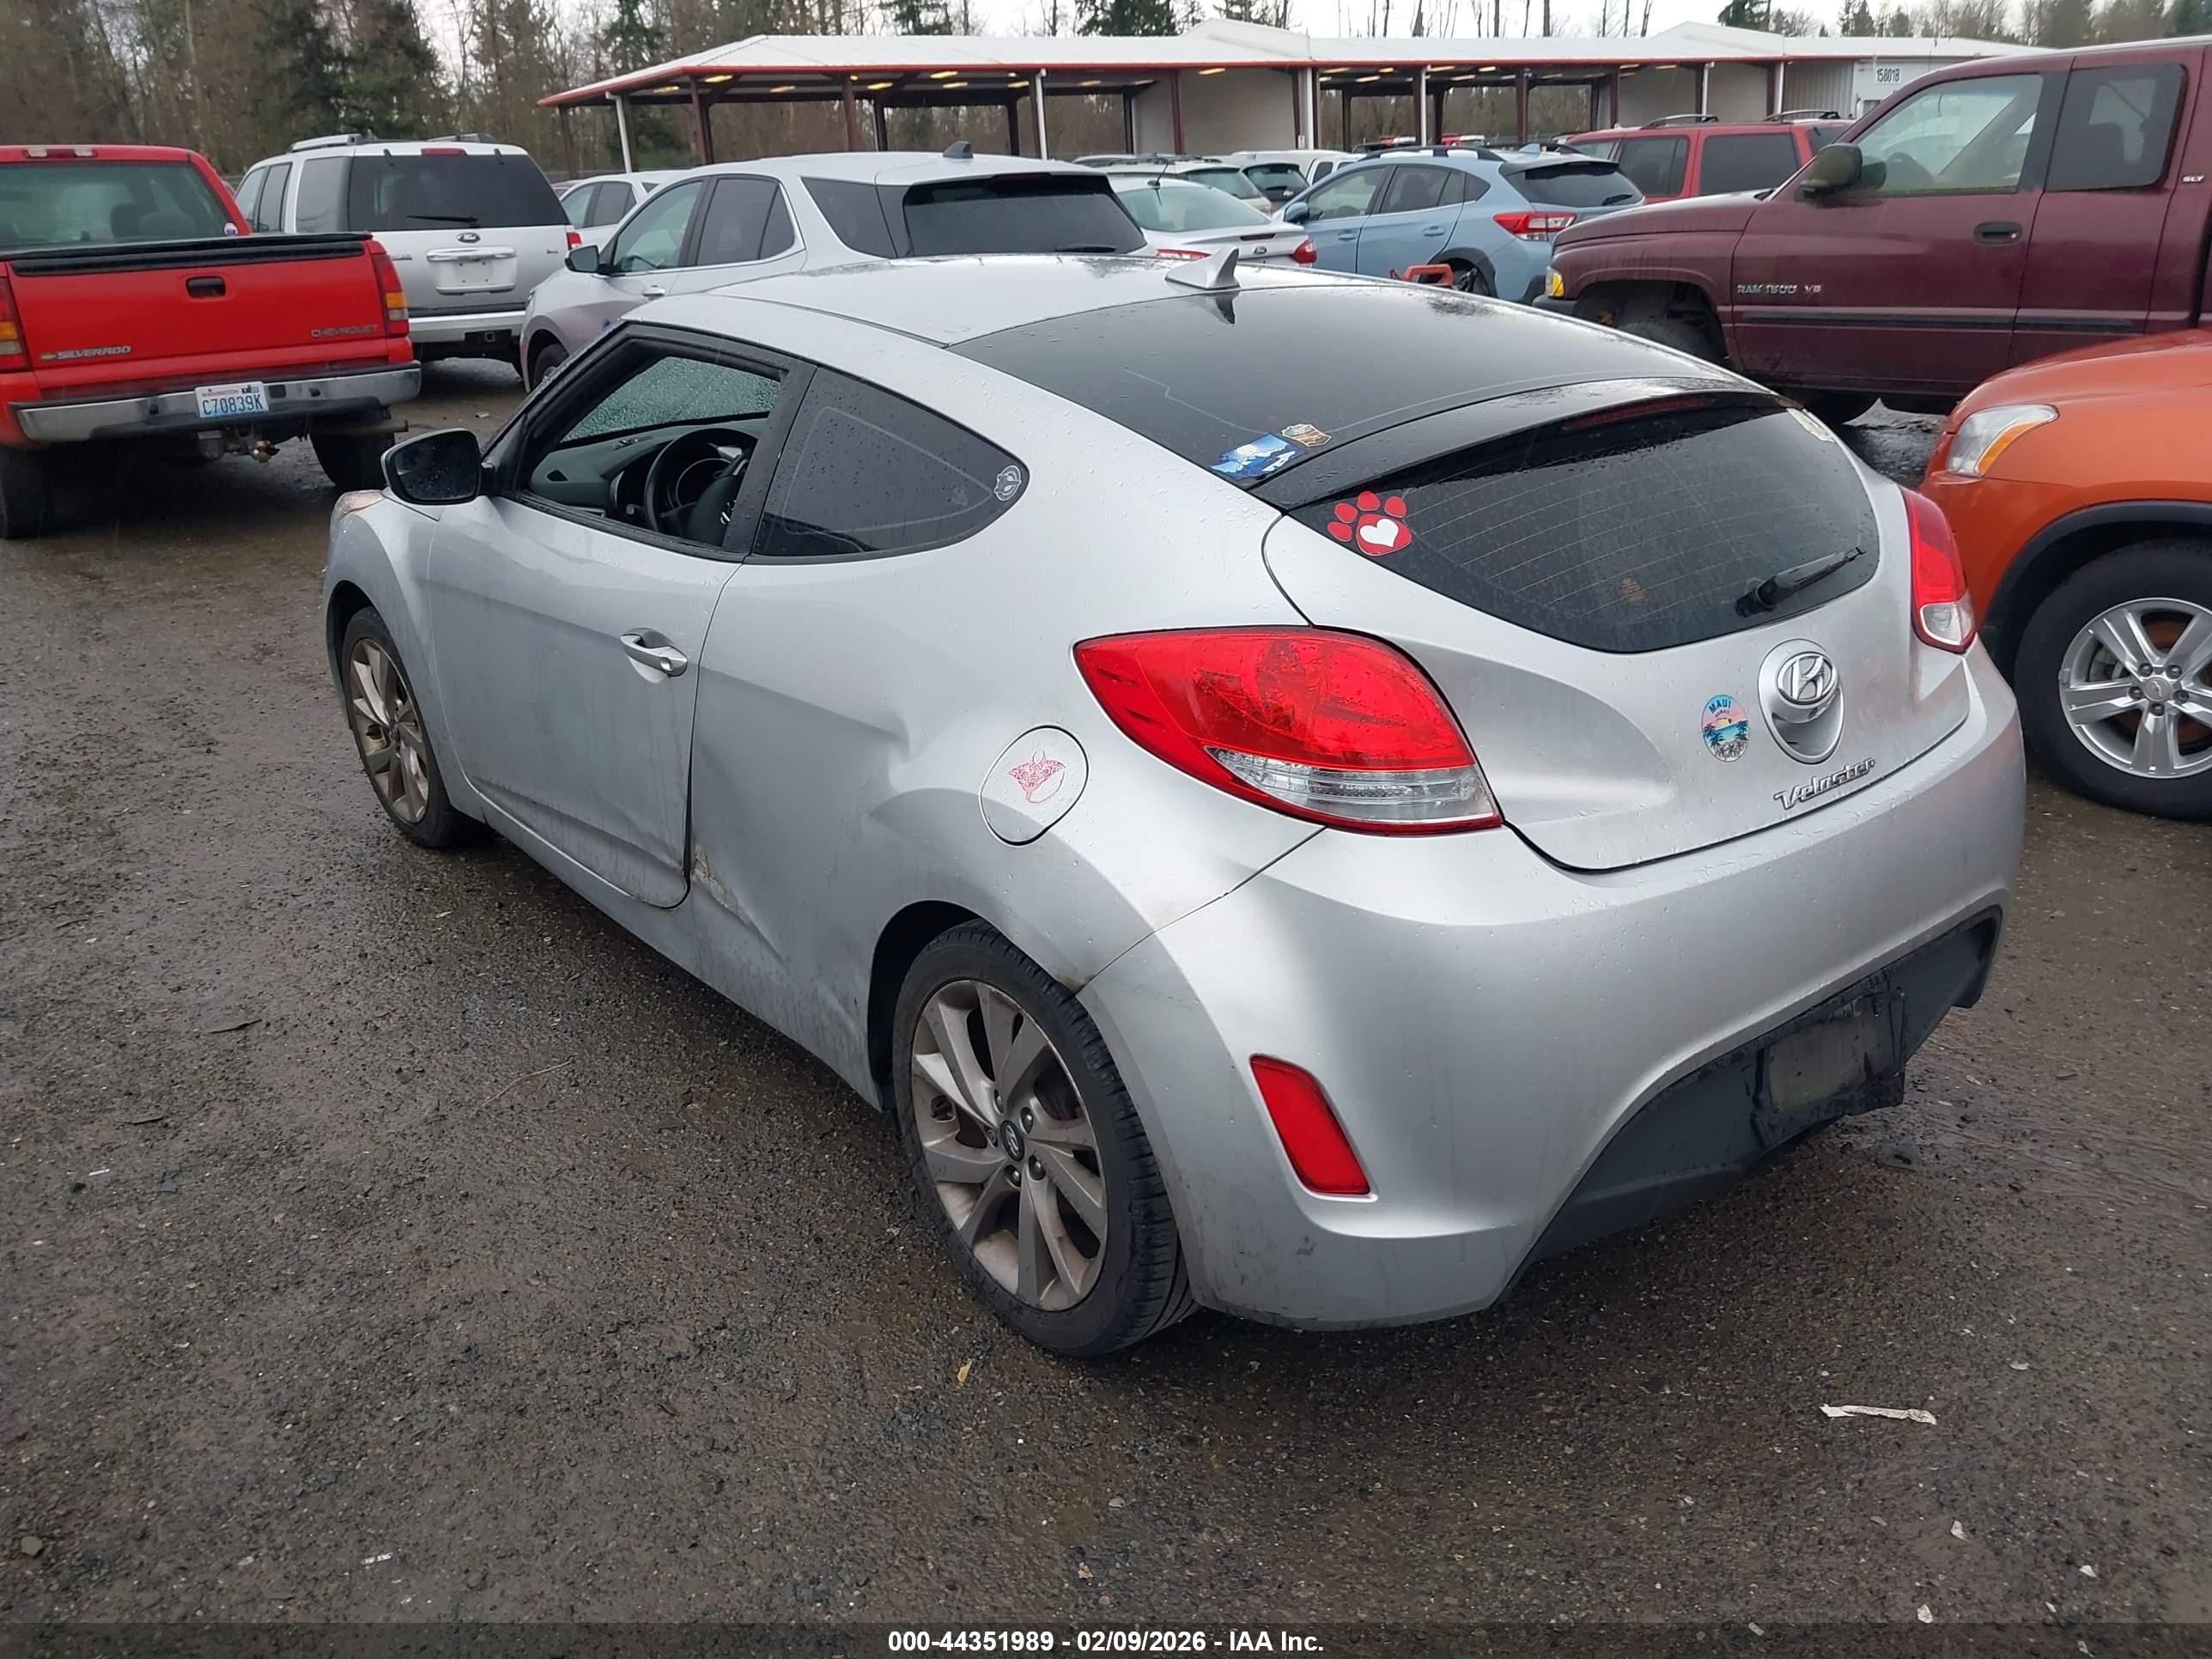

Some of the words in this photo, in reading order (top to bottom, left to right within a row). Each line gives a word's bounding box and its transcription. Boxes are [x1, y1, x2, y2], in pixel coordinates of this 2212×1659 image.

[1876, 68, 1899, 82] 158018
[1737, 284, 1763, 294] RAM
[1765, 284, 1797, 294] 1500
[311, 324, 378, 337] CHEVROLET
[57, 345, 132, 359] SILVERADO
[202, 393, 263, 415] C70839K
[1709, 698, 1731, 714] MAUI
[1773, 757, 1875, 810] Veloster
